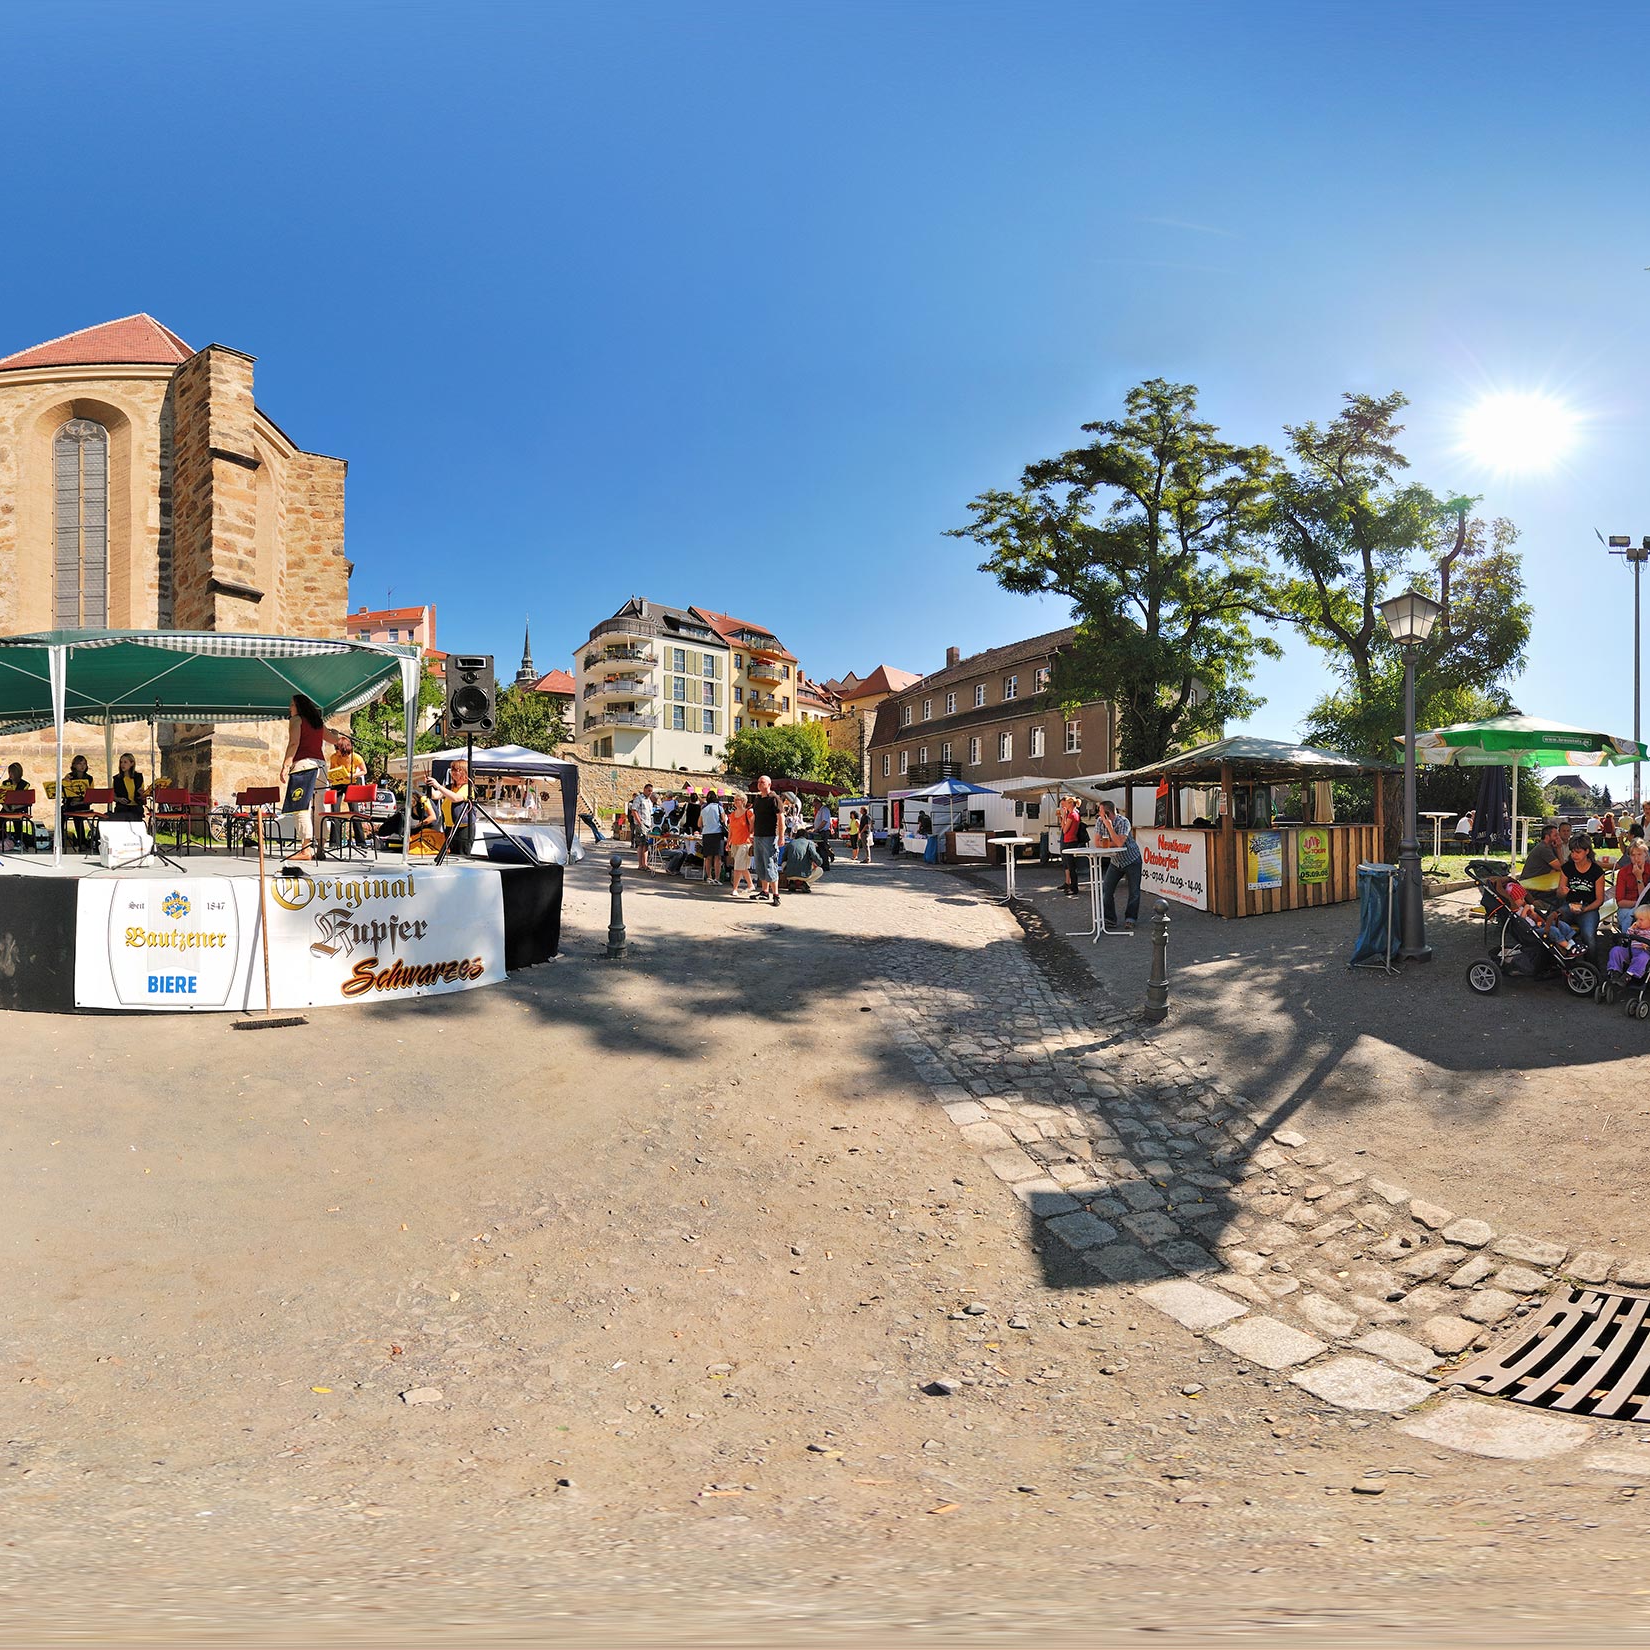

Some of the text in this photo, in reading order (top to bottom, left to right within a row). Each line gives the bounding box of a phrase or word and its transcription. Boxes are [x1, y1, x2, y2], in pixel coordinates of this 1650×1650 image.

[1143, 846, 1180, 871] Oktoberfest
[270, 873, 417, 911] Original
[128, 901, 226, 911] Seit 1847
[124, 926, 227, 953] Bautzener
[309, 908, 429, 959] Kupfer
[147, 975, 197, 994] BIERE
[340, 955, 486, 999] Schwarzes
